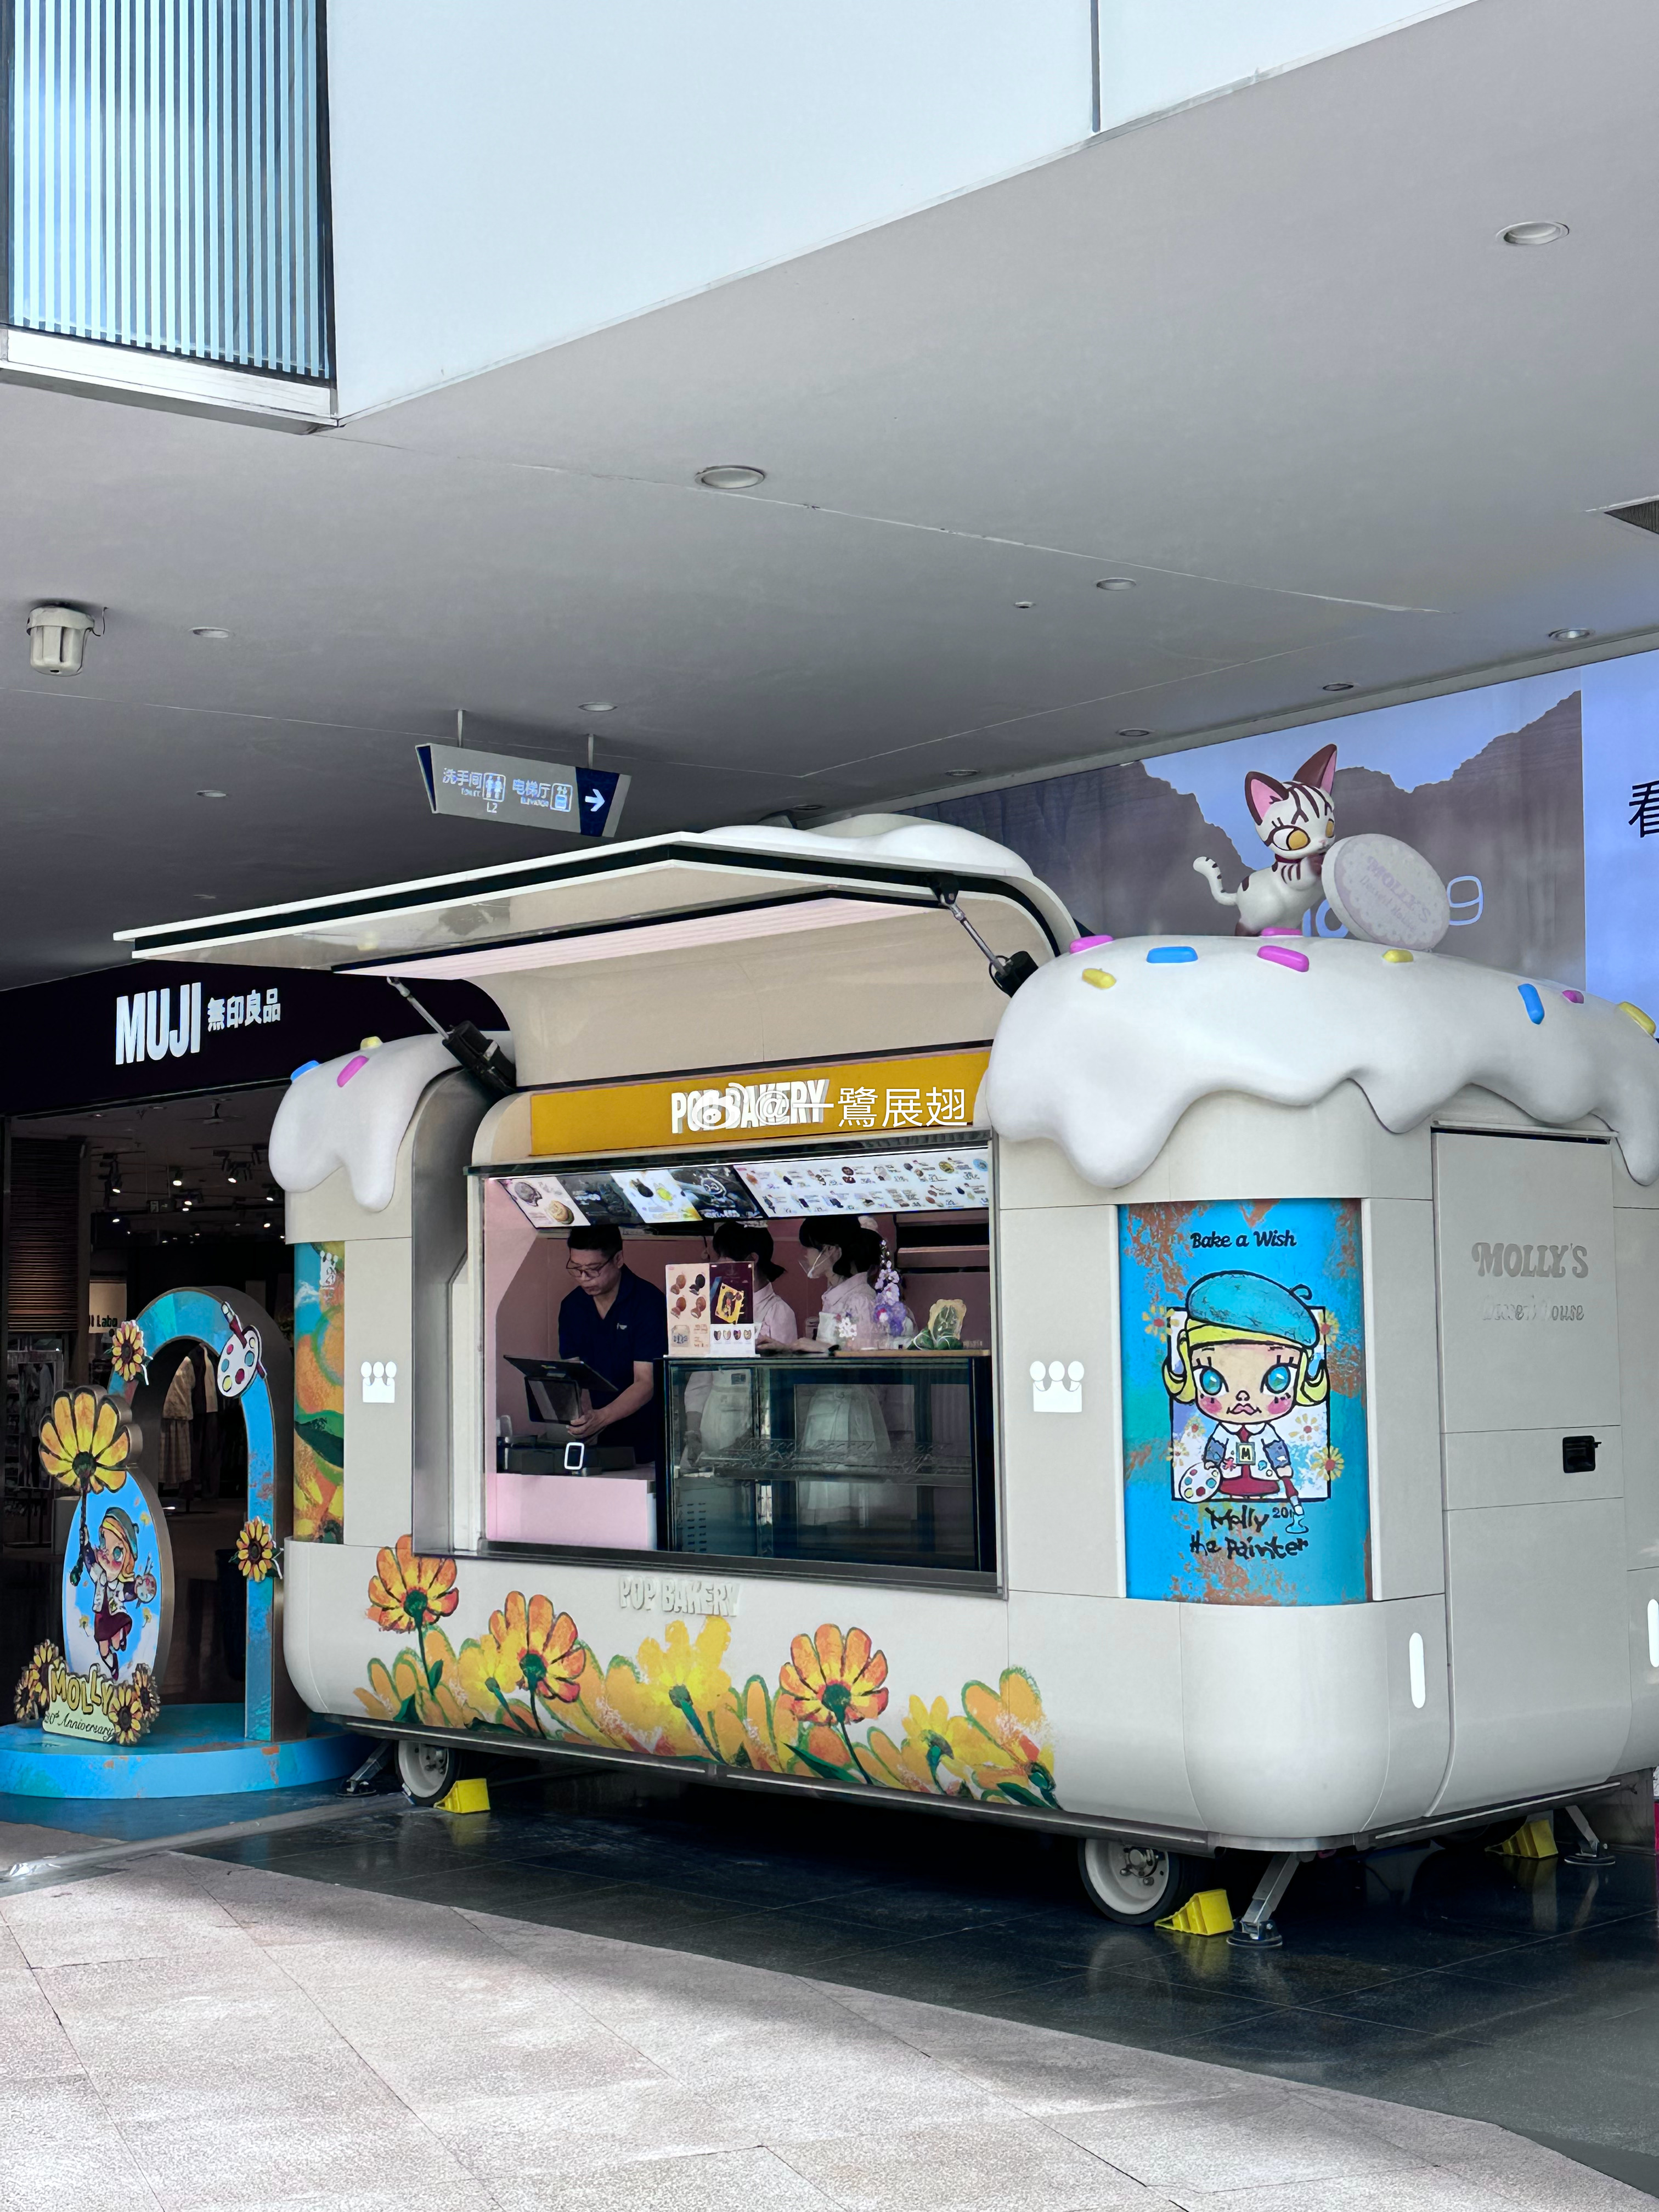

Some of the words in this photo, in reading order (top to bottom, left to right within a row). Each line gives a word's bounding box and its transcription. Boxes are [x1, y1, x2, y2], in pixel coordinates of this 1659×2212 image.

[442, 768, 483, 788] 洗手间
[512, 779, 551, 799] 电梯厅
[487, 802, 497, 813] L2
[116, 982, 201, 1065] MUJI
[207, 988, 281, 1032] 無印良品
[725, 1079, 830, 1130] BAKERY
[1190, 1231, 1232, 1249] Bake
[1235, 1234, 1250, 1248] a
[1253, 1229, 1297, 1247] Wish
[1471, 1242, 1589, 1279] MOLLY'S
[1205, 1505, 1269, 1533] Molly
[619, 1576, 657, 1611] POP
[661, 1577, 741, 1617] BAKERY
[50, 1669, 114, 1717] MOLLY
